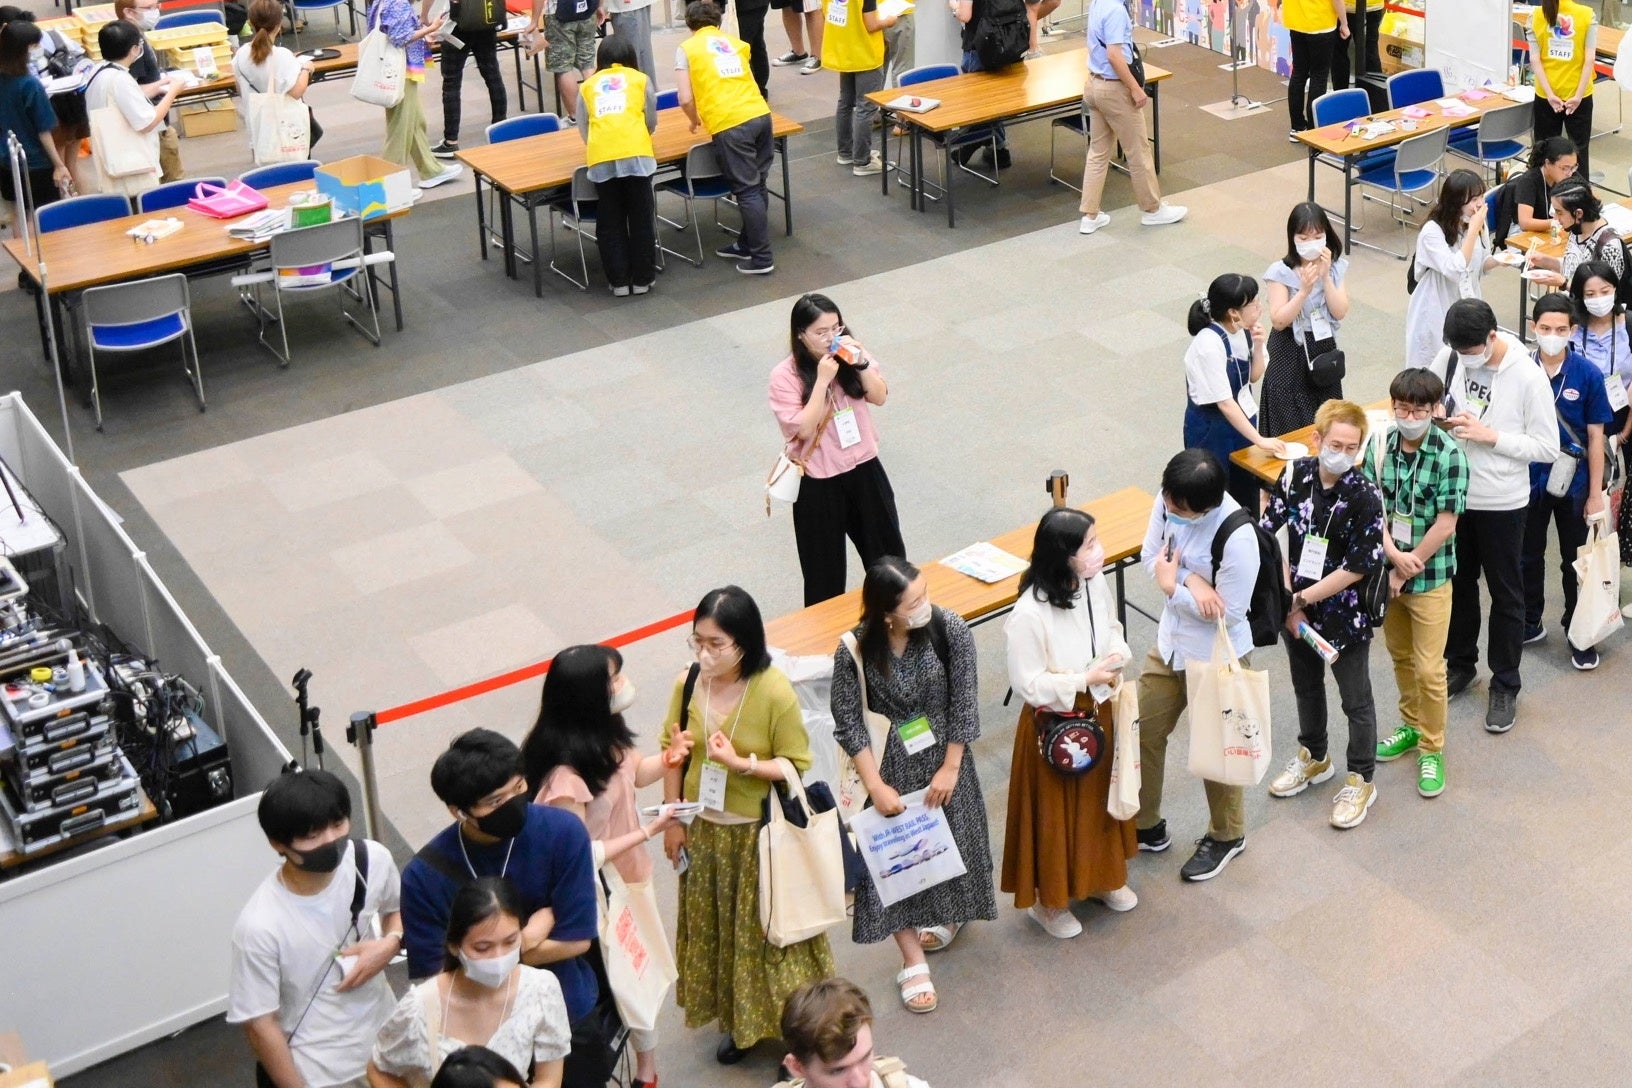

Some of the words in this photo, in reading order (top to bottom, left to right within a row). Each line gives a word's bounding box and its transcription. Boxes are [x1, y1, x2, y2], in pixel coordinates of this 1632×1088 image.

[828, 14, 846, 24] STAFF
[598, 105, 623, 115] STAFF
[872, 832, 885, 842] With
[884, 823, 904, 838] JR-WEST
[904, 819, 916, 830] RAIL
[869, 843, 884, 853] Enjoy
